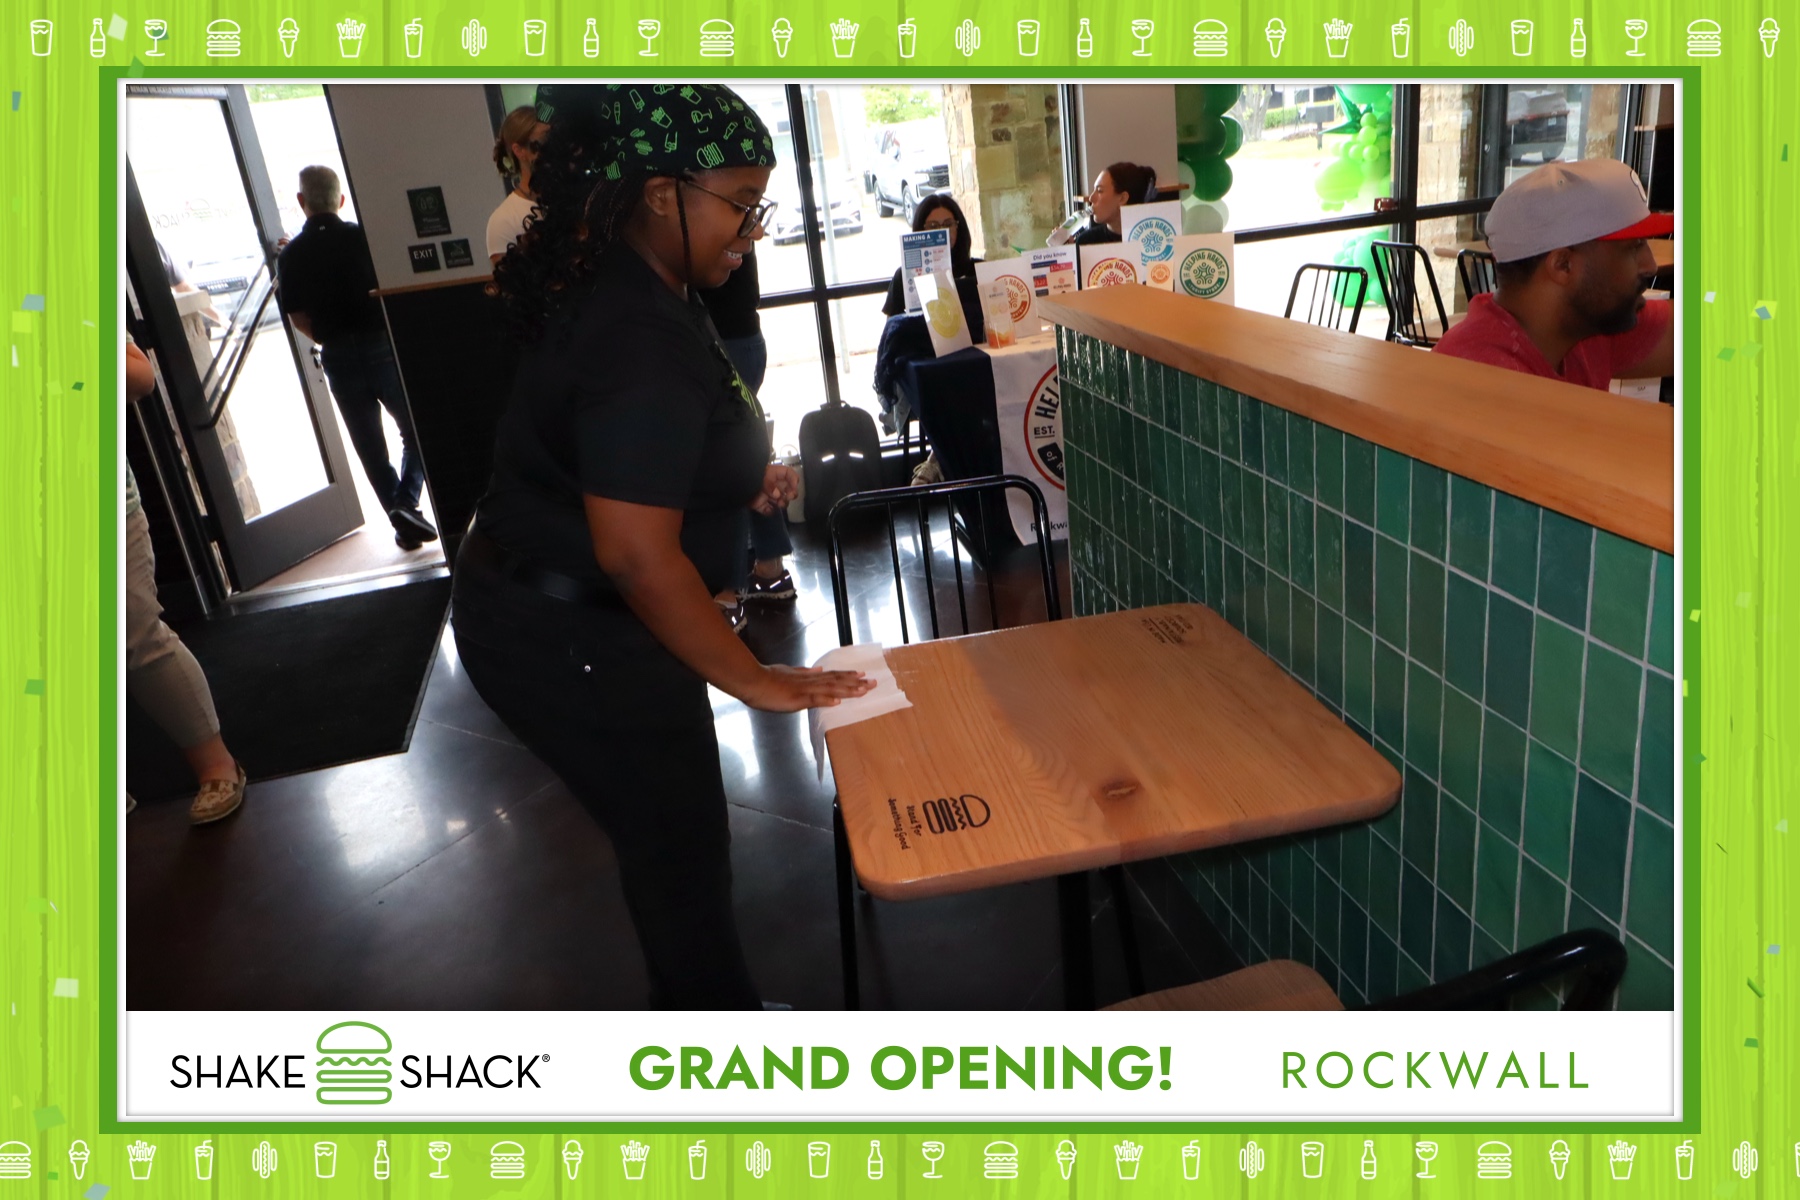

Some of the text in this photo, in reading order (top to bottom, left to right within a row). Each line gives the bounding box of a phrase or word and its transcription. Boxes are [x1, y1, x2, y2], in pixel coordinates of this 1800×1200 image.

[1132, 220, 1173, 240] HELPING HANDS
[904, 235, 926, 243] MAKING
[413, 248, 433, 259] EXIT
[1184, 251, 1225, 271] HELPING HANDS
[1033, 425, 1055, 436] EST.
[887, 798, 911, 850] Something Good
